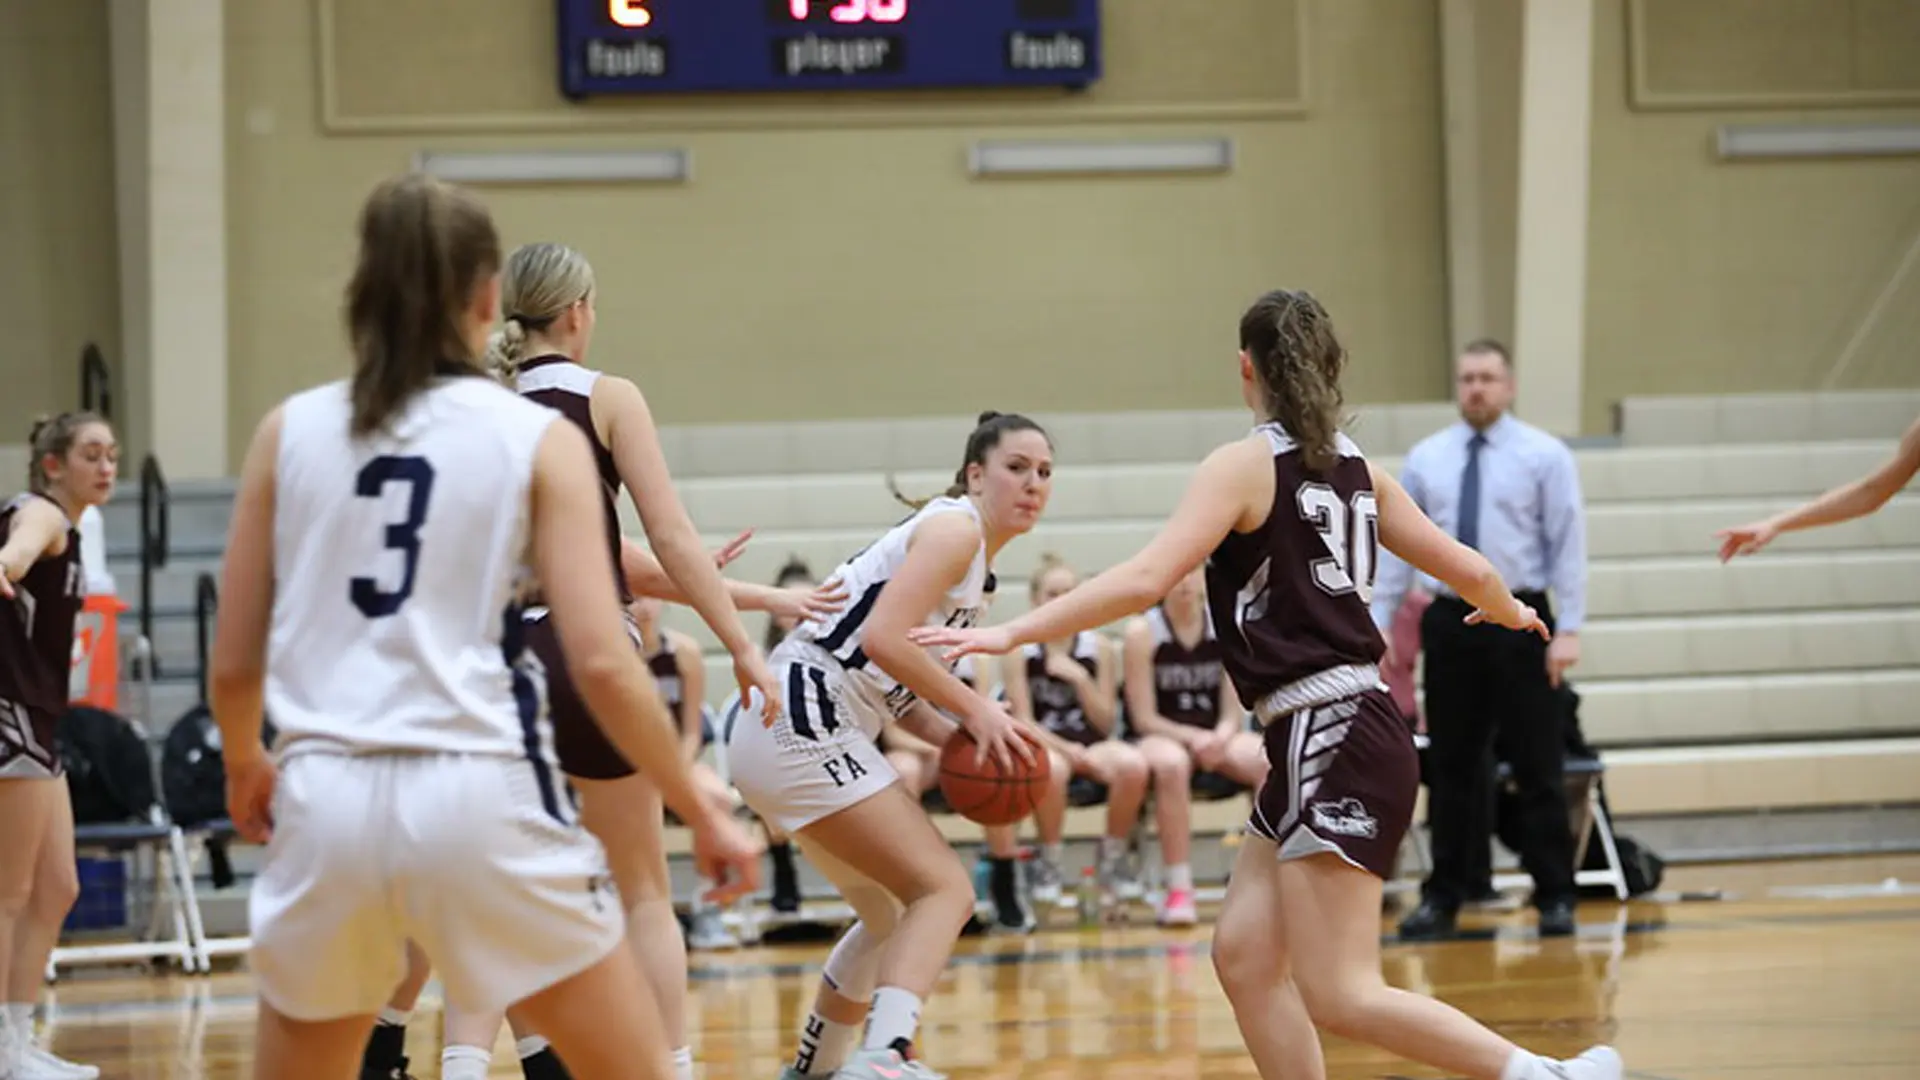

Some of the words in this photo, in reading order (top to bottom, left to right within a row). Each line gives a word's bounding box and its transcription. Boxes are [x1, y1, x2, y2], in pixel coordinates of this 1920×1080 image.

[785, 30, 890, 76] player
[349, 455, 436, 619] 3
[1295, 480, 1378, 606] 30
[823, 752, 867, 787] FA
